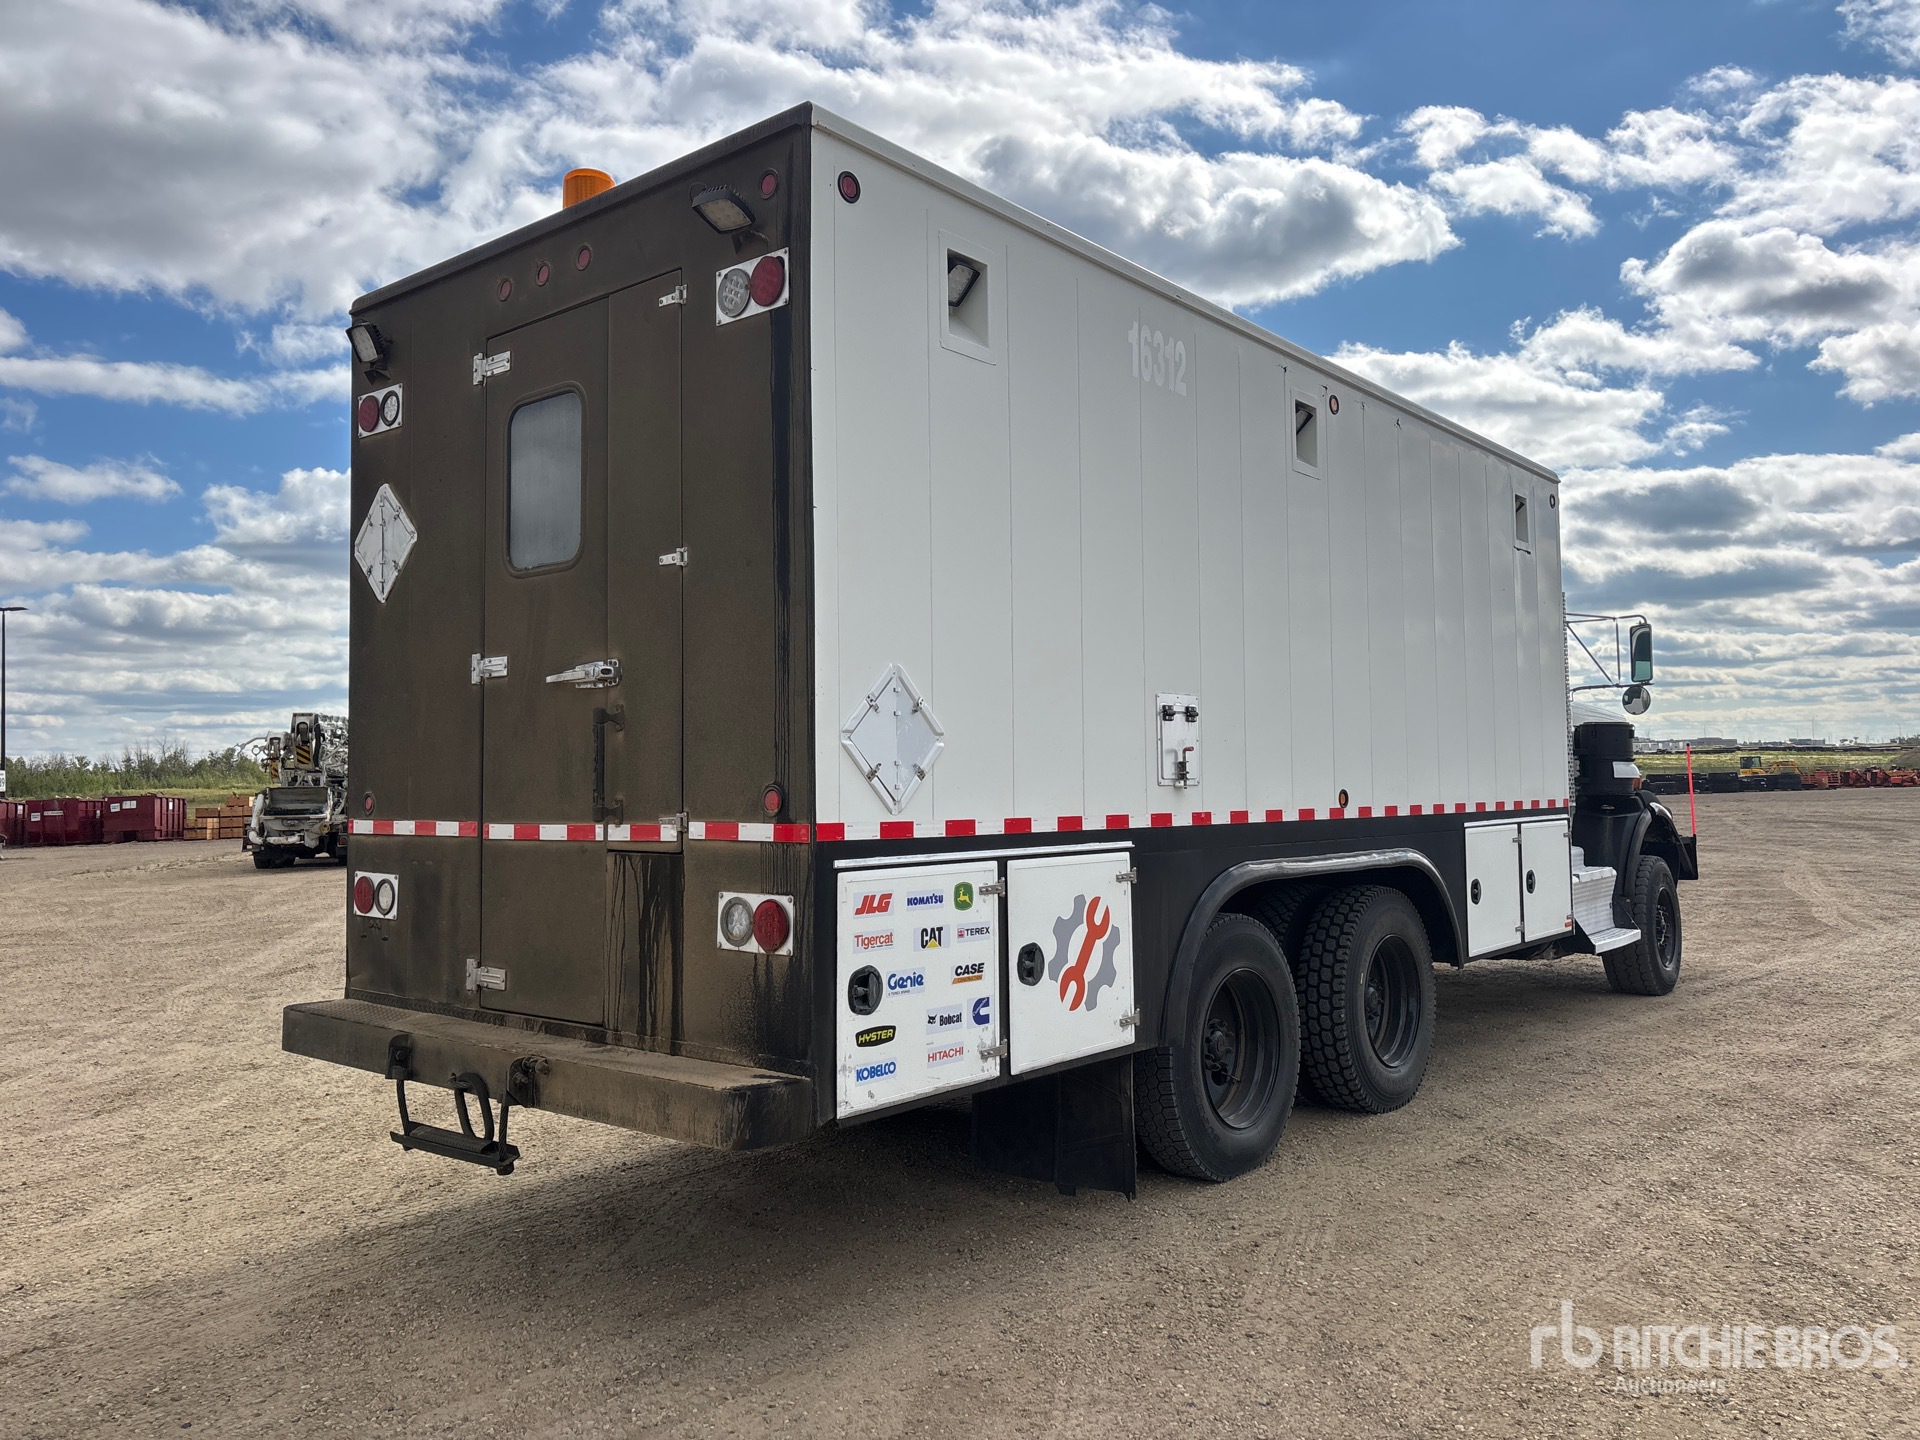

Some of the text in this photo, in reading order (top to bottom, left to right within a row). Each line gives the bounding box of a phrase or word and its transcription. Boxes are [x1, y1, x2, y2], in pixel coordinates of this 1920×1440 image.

[1128, 320, 1187, 397] 16312
[854, 893, 893, 915] JLG
[907, 893, 944, 906] KOMATSU
[921, 926, 944, 949] CAT
[965, 926, 990, 937] TEREX
[854, 932, 894, 950] Tigercat
[955, 962, 985, 976] CASE
[887, 971, 924, 990] Genie
[939, 1012, 962, 1026] Bobcat
[858, 1029, 894, 1044] HYSTER
[927, 1046, 964, 1062] HITACHI
[856, 1061, 897, 1082] KOBELCO
